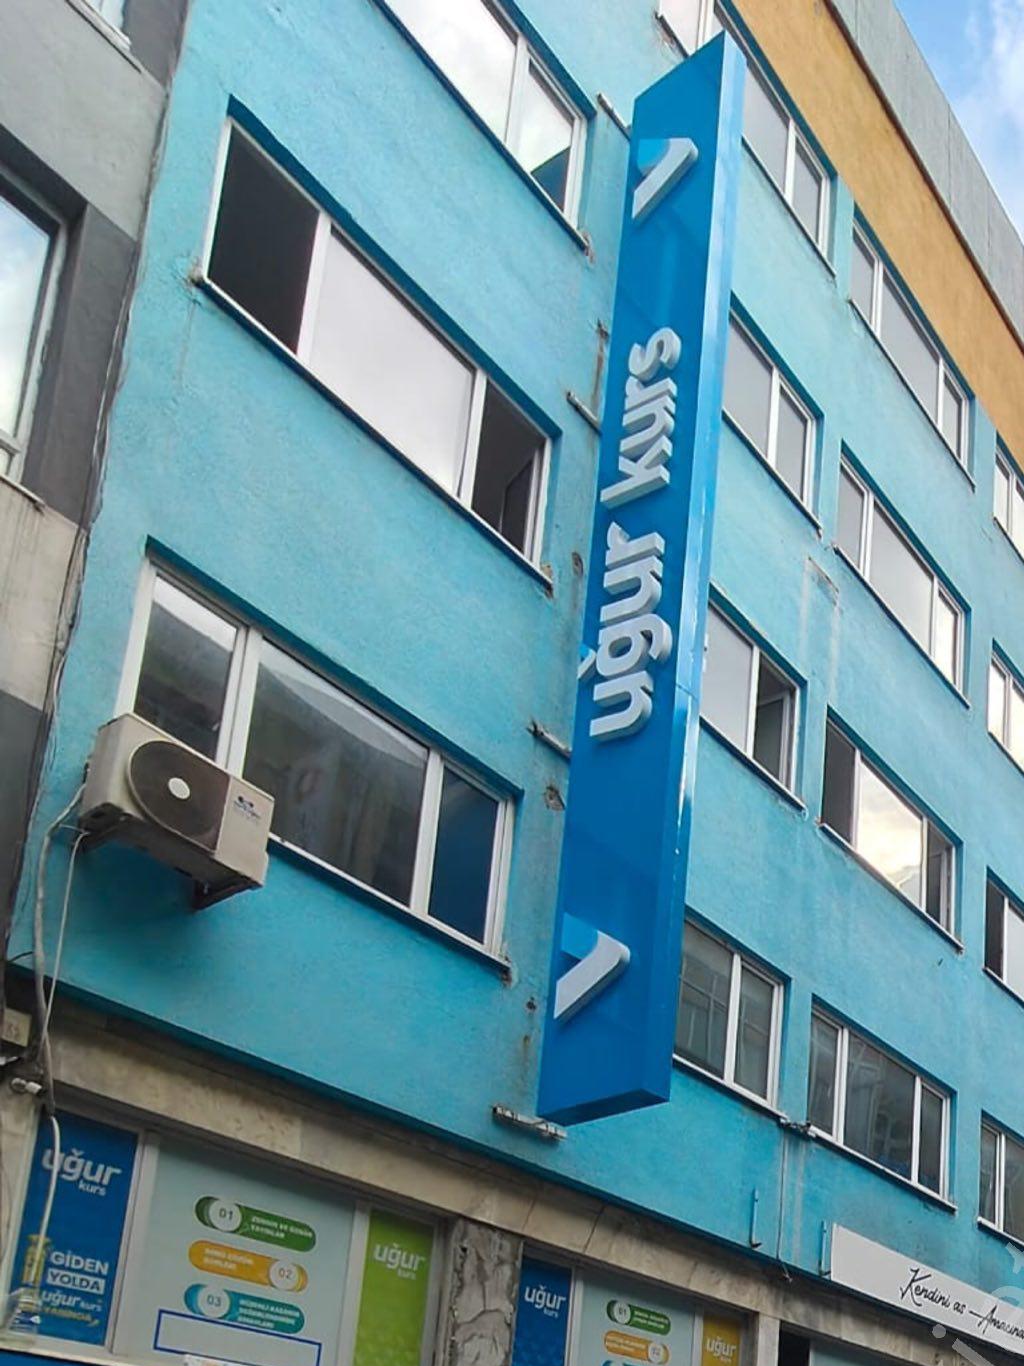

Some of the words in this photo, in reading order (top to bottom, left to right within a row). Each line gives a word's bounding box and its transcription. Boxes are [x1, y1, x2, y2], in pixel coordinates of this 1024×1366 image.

[601, 326, 682, 508] kurs
[577, 521, 673, 741] uğur
[42, 1147, 122, 1186] uğur
[78, 1181, 106, 1196] kurs
[219, 1207, 234, 1220] 01
[50, 1250, 109, 1275] GİDEN
[375, 1242, 426, 1271] uğur
[49, 1271, 101, 1292] YOLDA
[279, 1267, 293, 1280] 02
[206, 1293, 222, 1307] 03
[524, 1284, 567, 1310] uğur
[899, 1267, 951, 1308] Kendini
[706, 1336, 737, 1358] uğur
